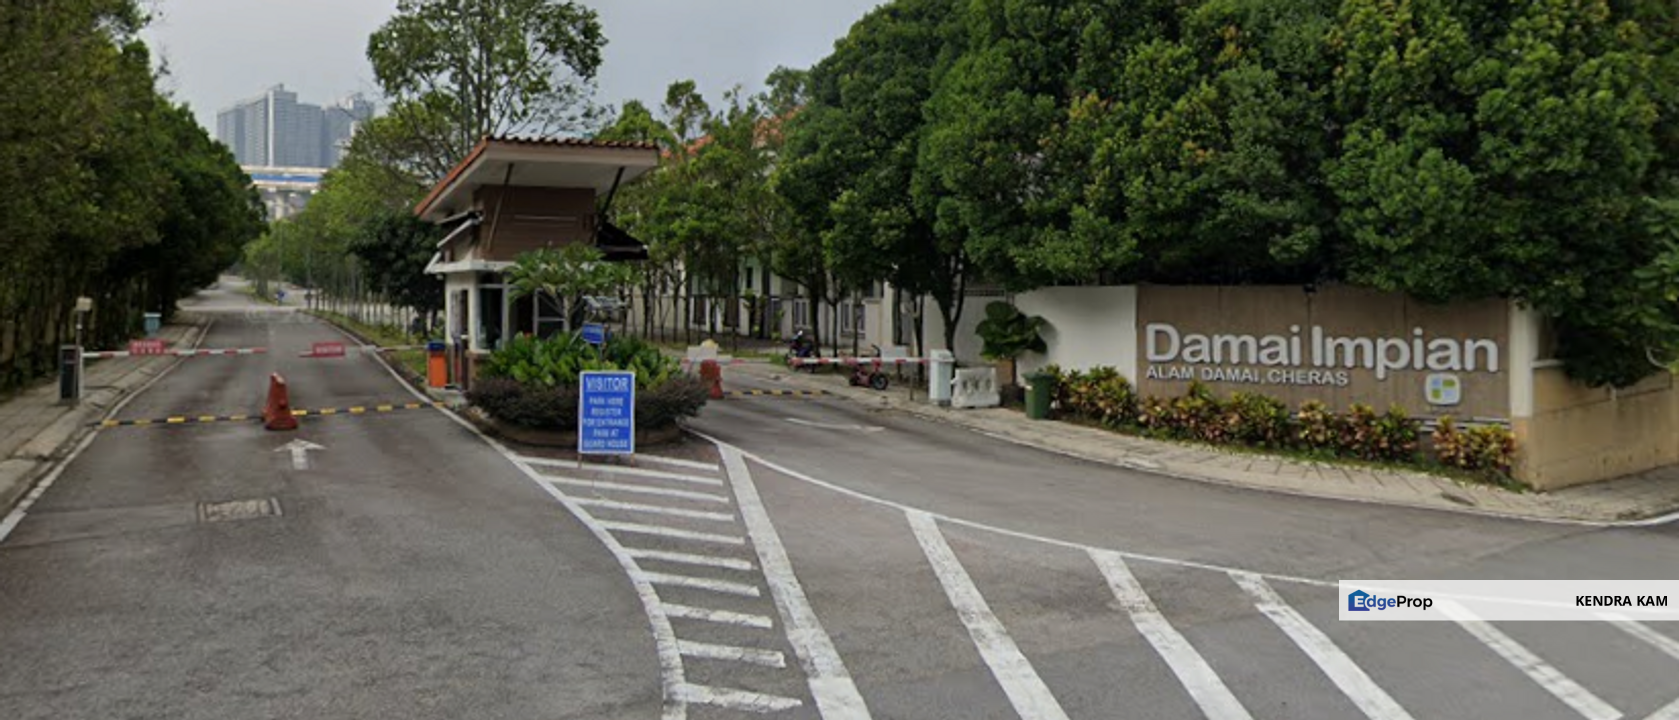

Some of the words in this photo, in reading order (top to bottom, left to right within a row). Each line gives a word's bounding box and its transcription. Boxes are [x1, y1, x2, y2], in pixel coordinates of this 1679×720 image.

[1145, 322, 1300, 366] Damai
[1311, 325, 1499, 380] Impian
[585, 376, 629, 392] VISITOR
[1147, 366, 1194, 379] ALAM
[1267, 369, 1349, 386] CHERAS
[589, 397, 605, 405] PARK
[607, 397, 623, 406] HERE
[592, 408, 622, 416] REGISTER
